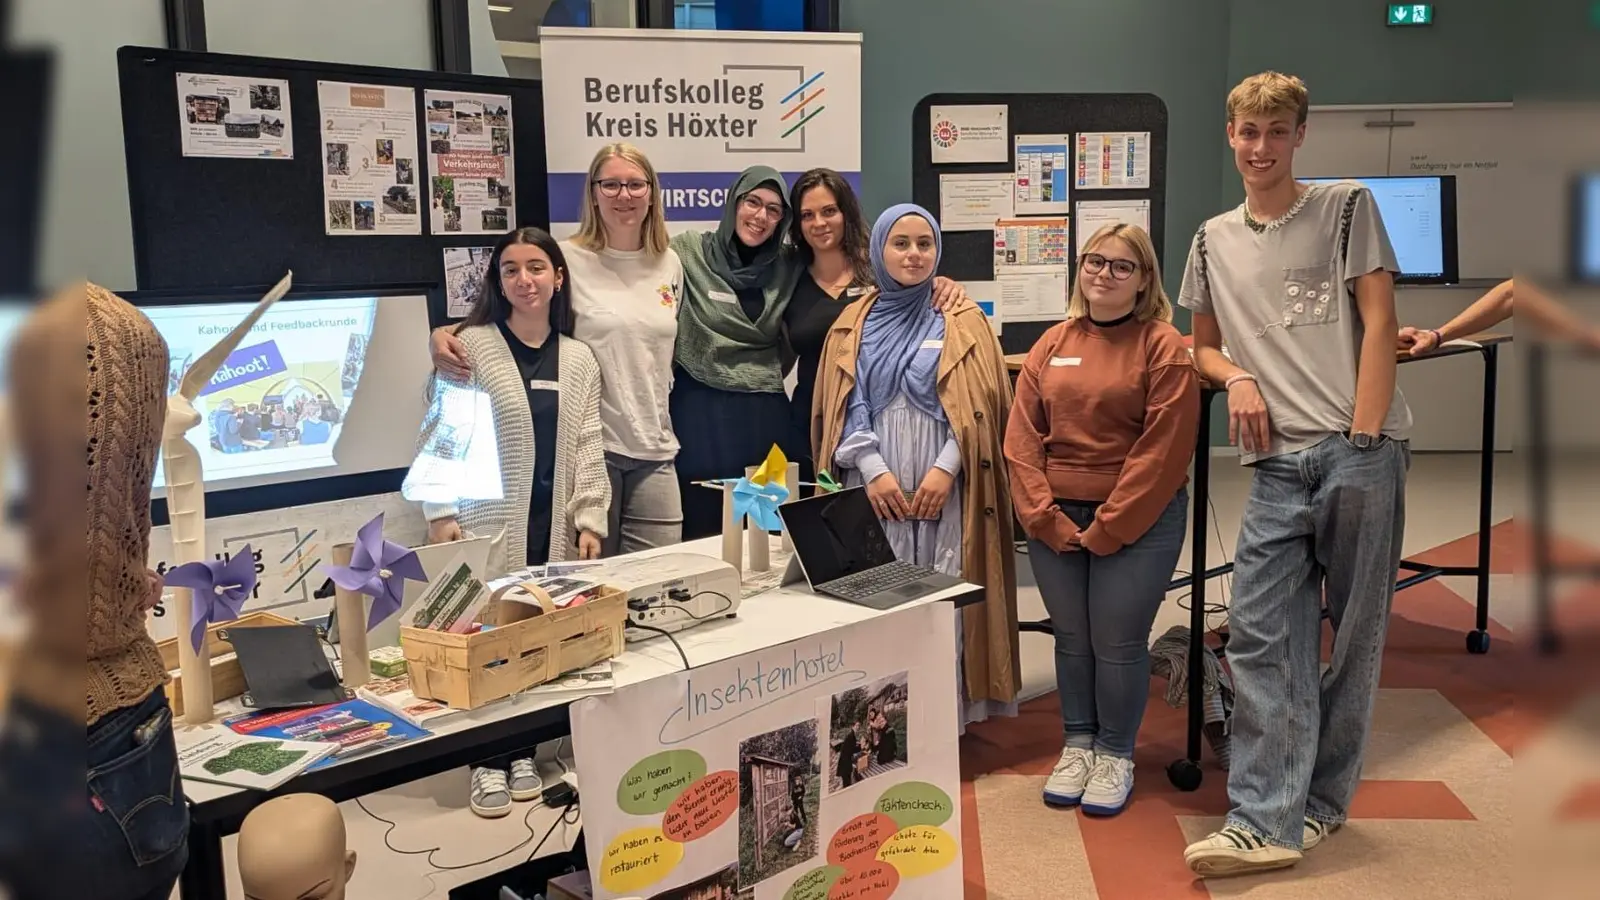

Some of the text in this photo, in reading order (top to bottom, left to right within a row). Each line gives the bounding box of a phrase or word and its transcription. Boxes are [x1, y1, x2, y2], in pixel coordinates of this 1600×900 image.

[584, 77, 764, 110] Berufskolleg
[326, 119, 334, 131] 2
[586, 111, 758, 138] Kreis Höxter
[362, 158, 370, 169] 3
[443, 159, 500, 170] Verkehrsinsel
[1410, 162, 1448, 171] Durchgang
[331, 179, 338, 190] 4
[270, 318, 357, 331] Feedbackrunde
[687, 640, 844, 721] Insektenhotel
[647, 765, 672, 779] haben
[633, 790, 647, 801] wir
[676, 775, 722, 809] wir haben
[666, 812, 681, 825] den
[694, 809, 722, 831] bauen
[866, 816, 879, 829] und
[868, 827, 879, 839] der
[922, 830, 937, 841] für
[608, 847, 620, 858] wir
[623, 836, 649, 851] haben
[838, 839, 880, 863] Biodiversität
